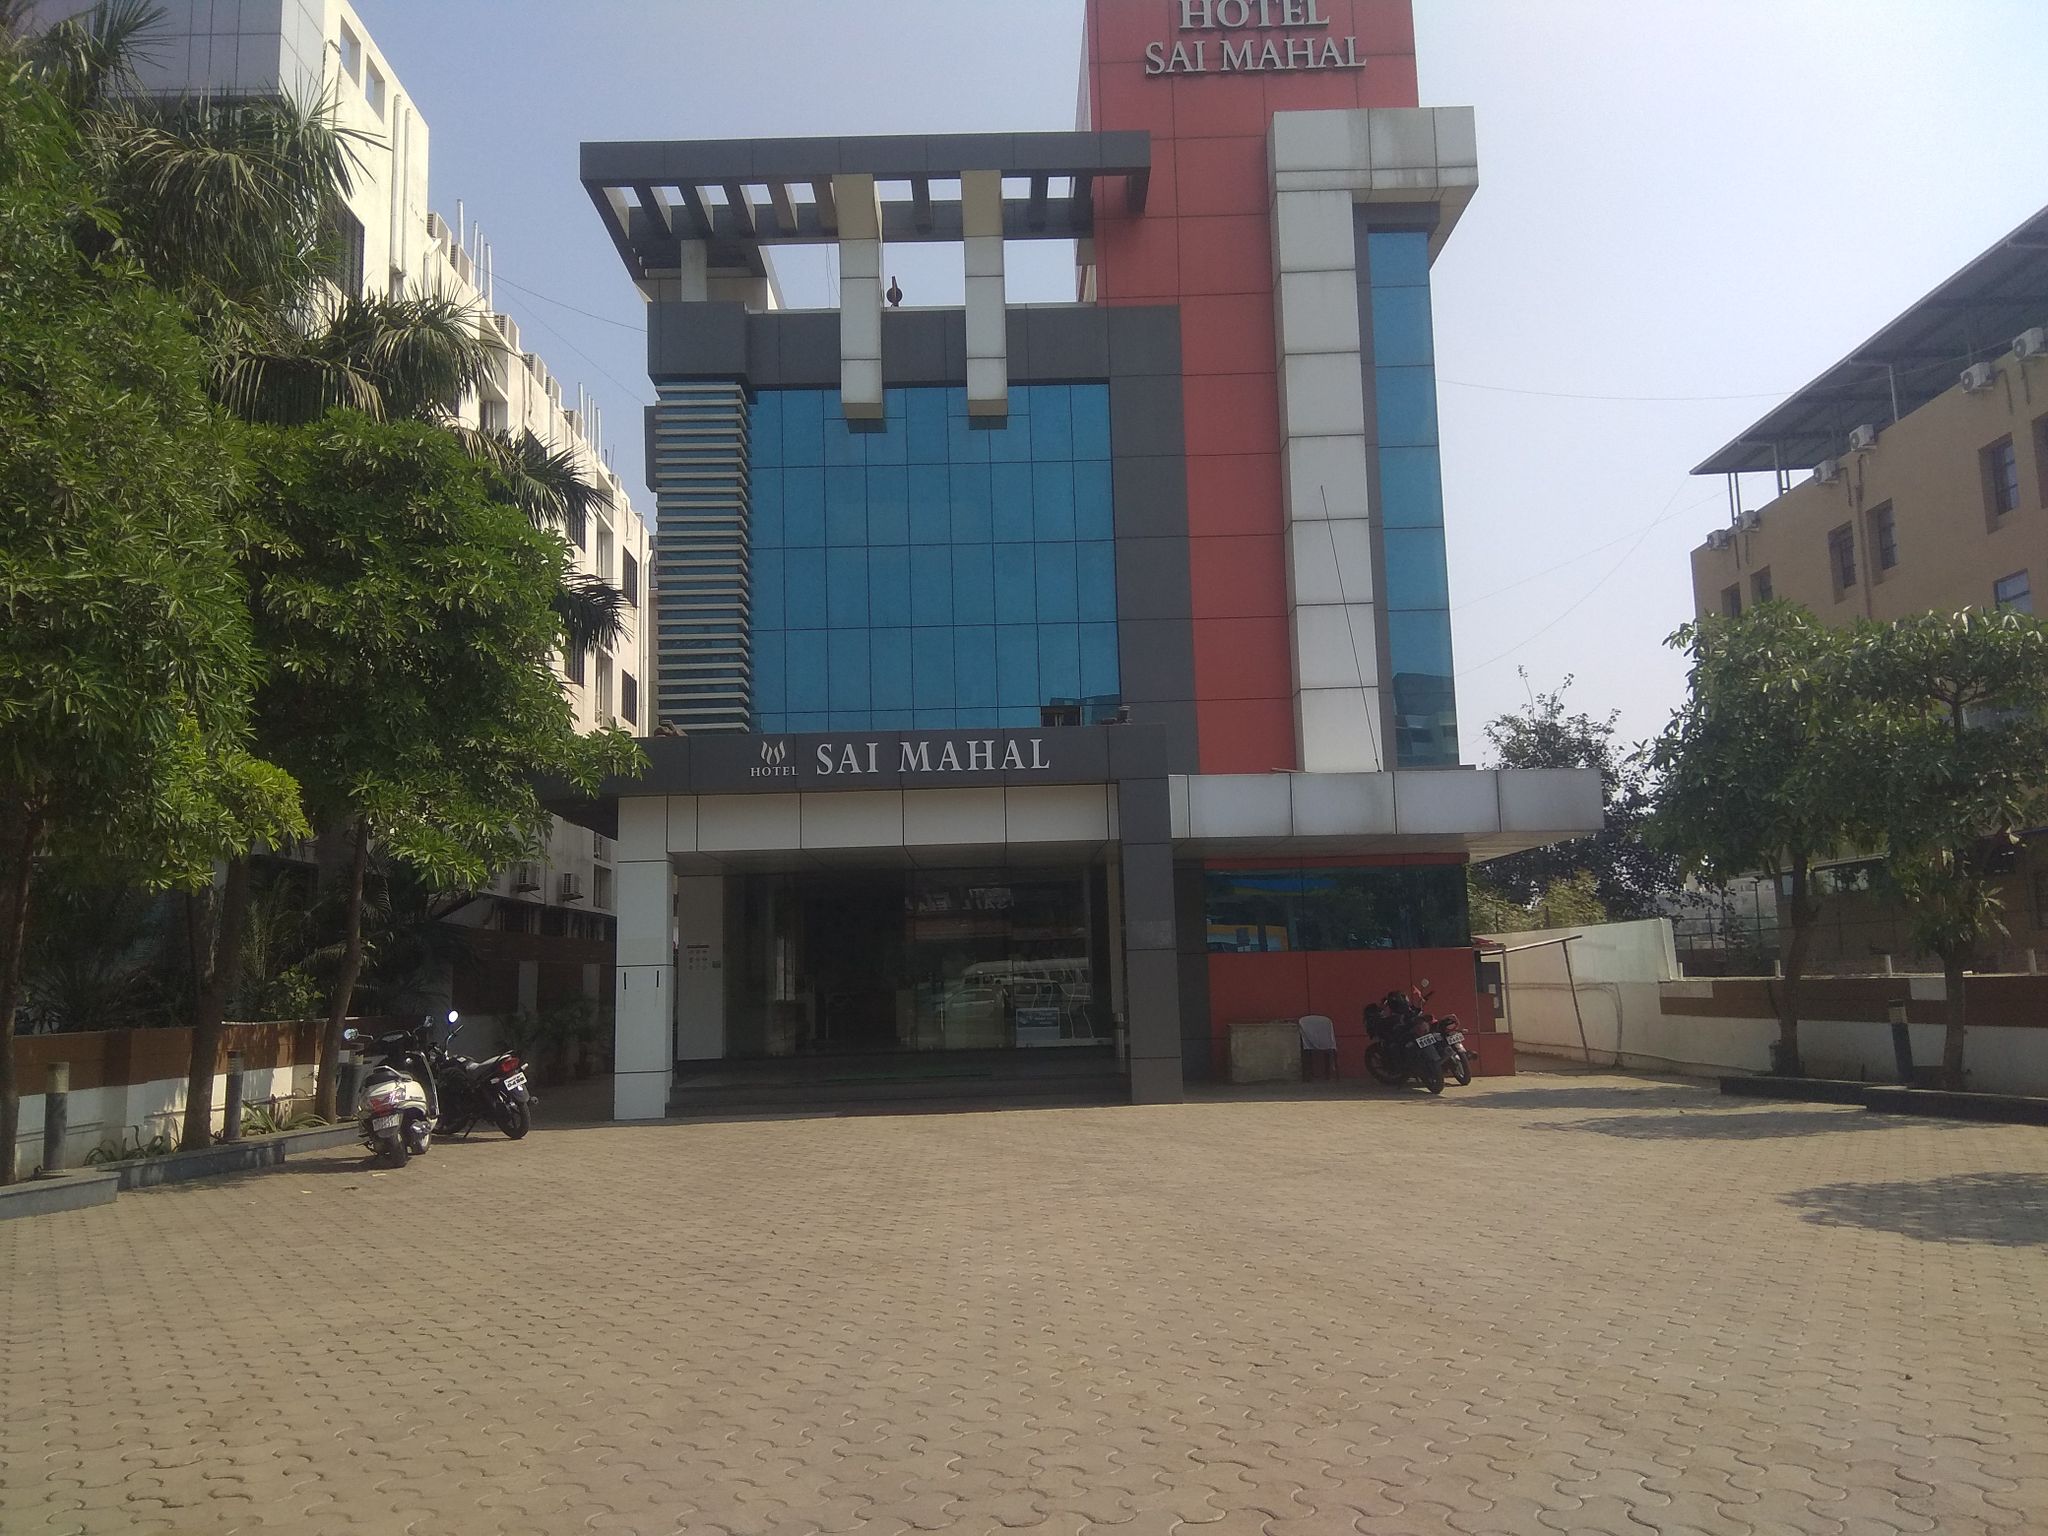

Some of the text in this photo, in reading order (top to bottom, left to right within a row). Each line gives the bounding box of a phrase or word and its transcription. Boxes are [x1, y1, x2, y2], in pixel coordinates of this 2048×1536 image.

[1179, 0, 1330, 28] HOTEL
[1145, 36, 1367, 74] SAI MAHAL
[750, 766, 799, 777] HOTEL
[815, 739, 1050, 775] SAI MAHAL
